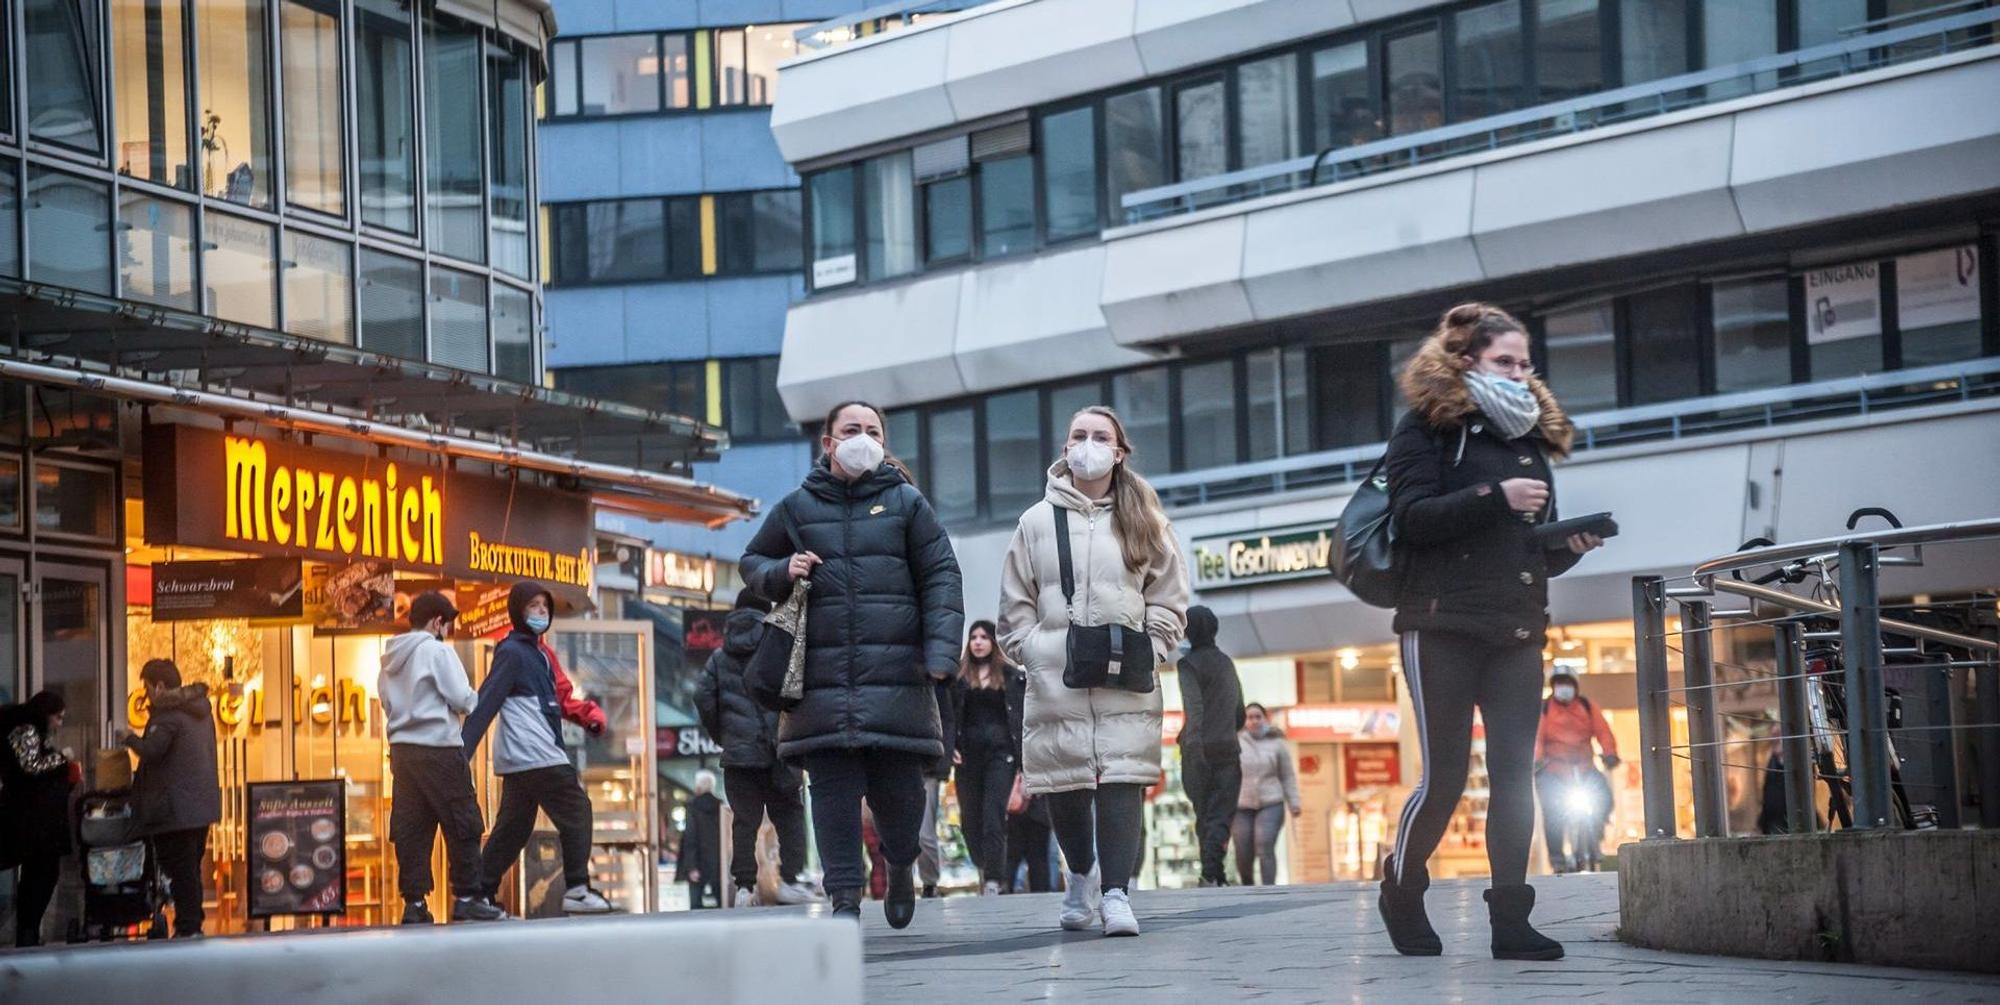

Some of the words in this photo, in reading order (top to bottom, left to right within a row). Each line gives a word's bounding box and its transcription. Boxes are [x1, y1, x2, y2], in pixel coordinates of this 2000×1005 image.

[1809, 263, 1876, 288] EINGANG
[224, 435, 444, 566] Merzenich
[555, 553, 576, 584] SEIT
[1194, 543, 1225, 580] Tee
[156, 577, 235, 594] Schwarzbrot
